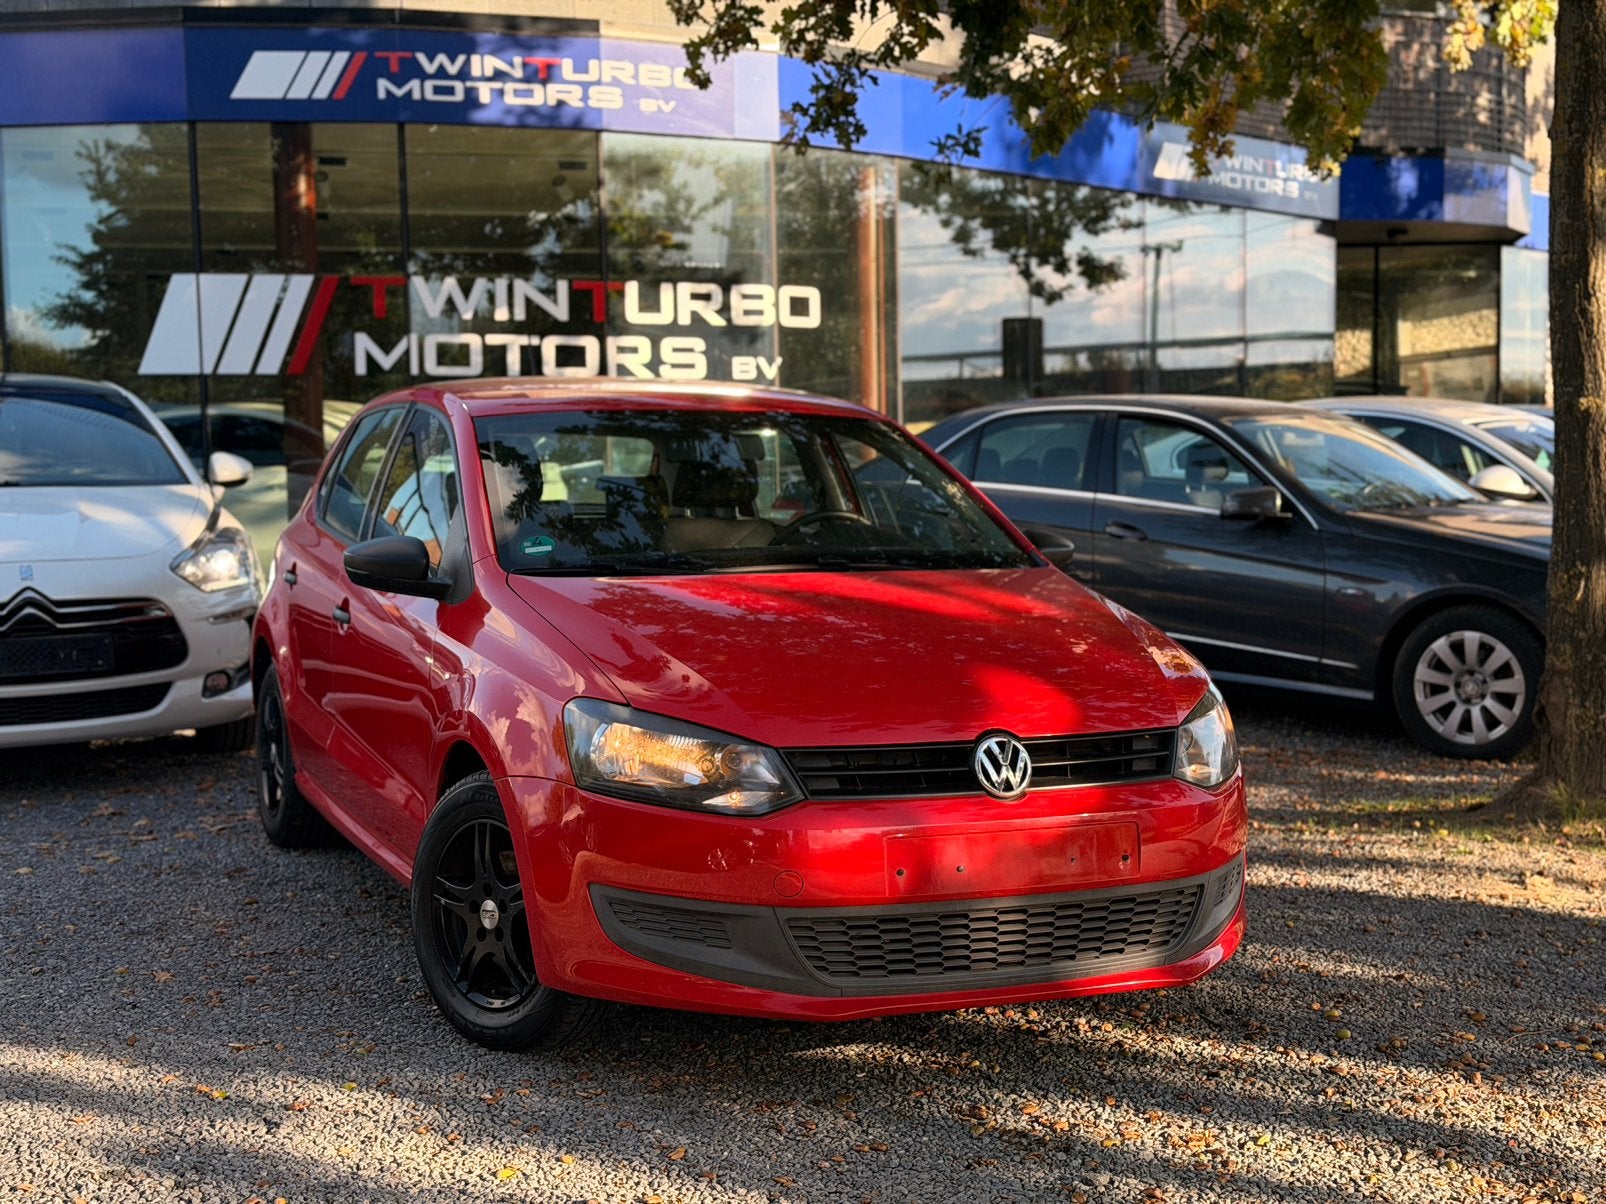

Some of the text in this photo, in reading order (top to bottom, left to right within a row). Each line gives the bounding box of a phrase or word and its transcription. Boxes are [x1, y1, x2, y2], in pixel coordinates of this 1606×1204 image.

[376, 77, 676, 113] MOTORS BV
[1208, 171, 1299, 198] MOTORS
[1210, 153, 1330, 184] WINTUR
[351, 275, 822, 329] TWINTURBO
[354, 331, 783, 380] MOTORS BV
[977, 738, 1028, 795] VW
